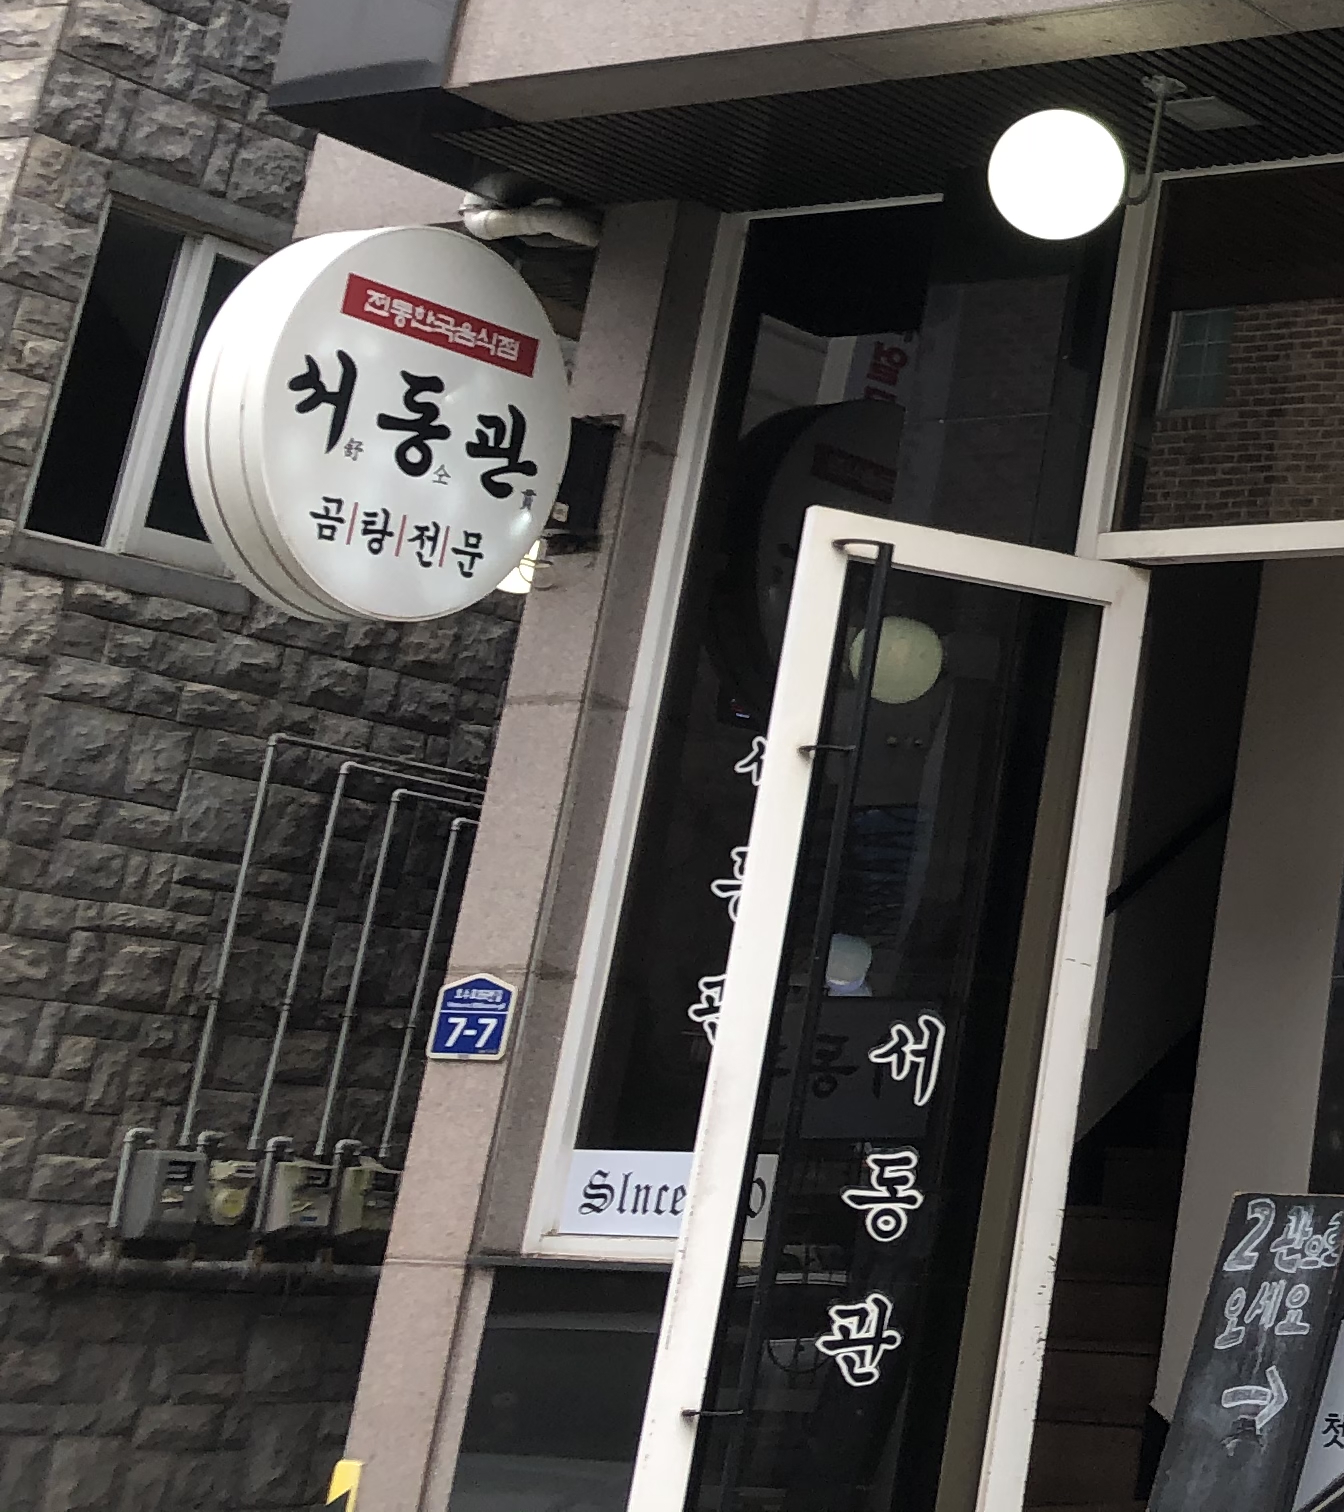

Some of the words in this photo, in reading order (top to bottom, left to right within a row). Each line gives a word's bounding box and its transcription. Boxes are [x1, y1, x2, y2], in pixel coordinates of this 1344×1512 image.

[288, 349, 538, 498] 서동관
[444, 1016, 499, 1049] 7-7
[816, 1014, 947, 1387] 서동관
[1213, 1278, 1311, 1350] 오세요
